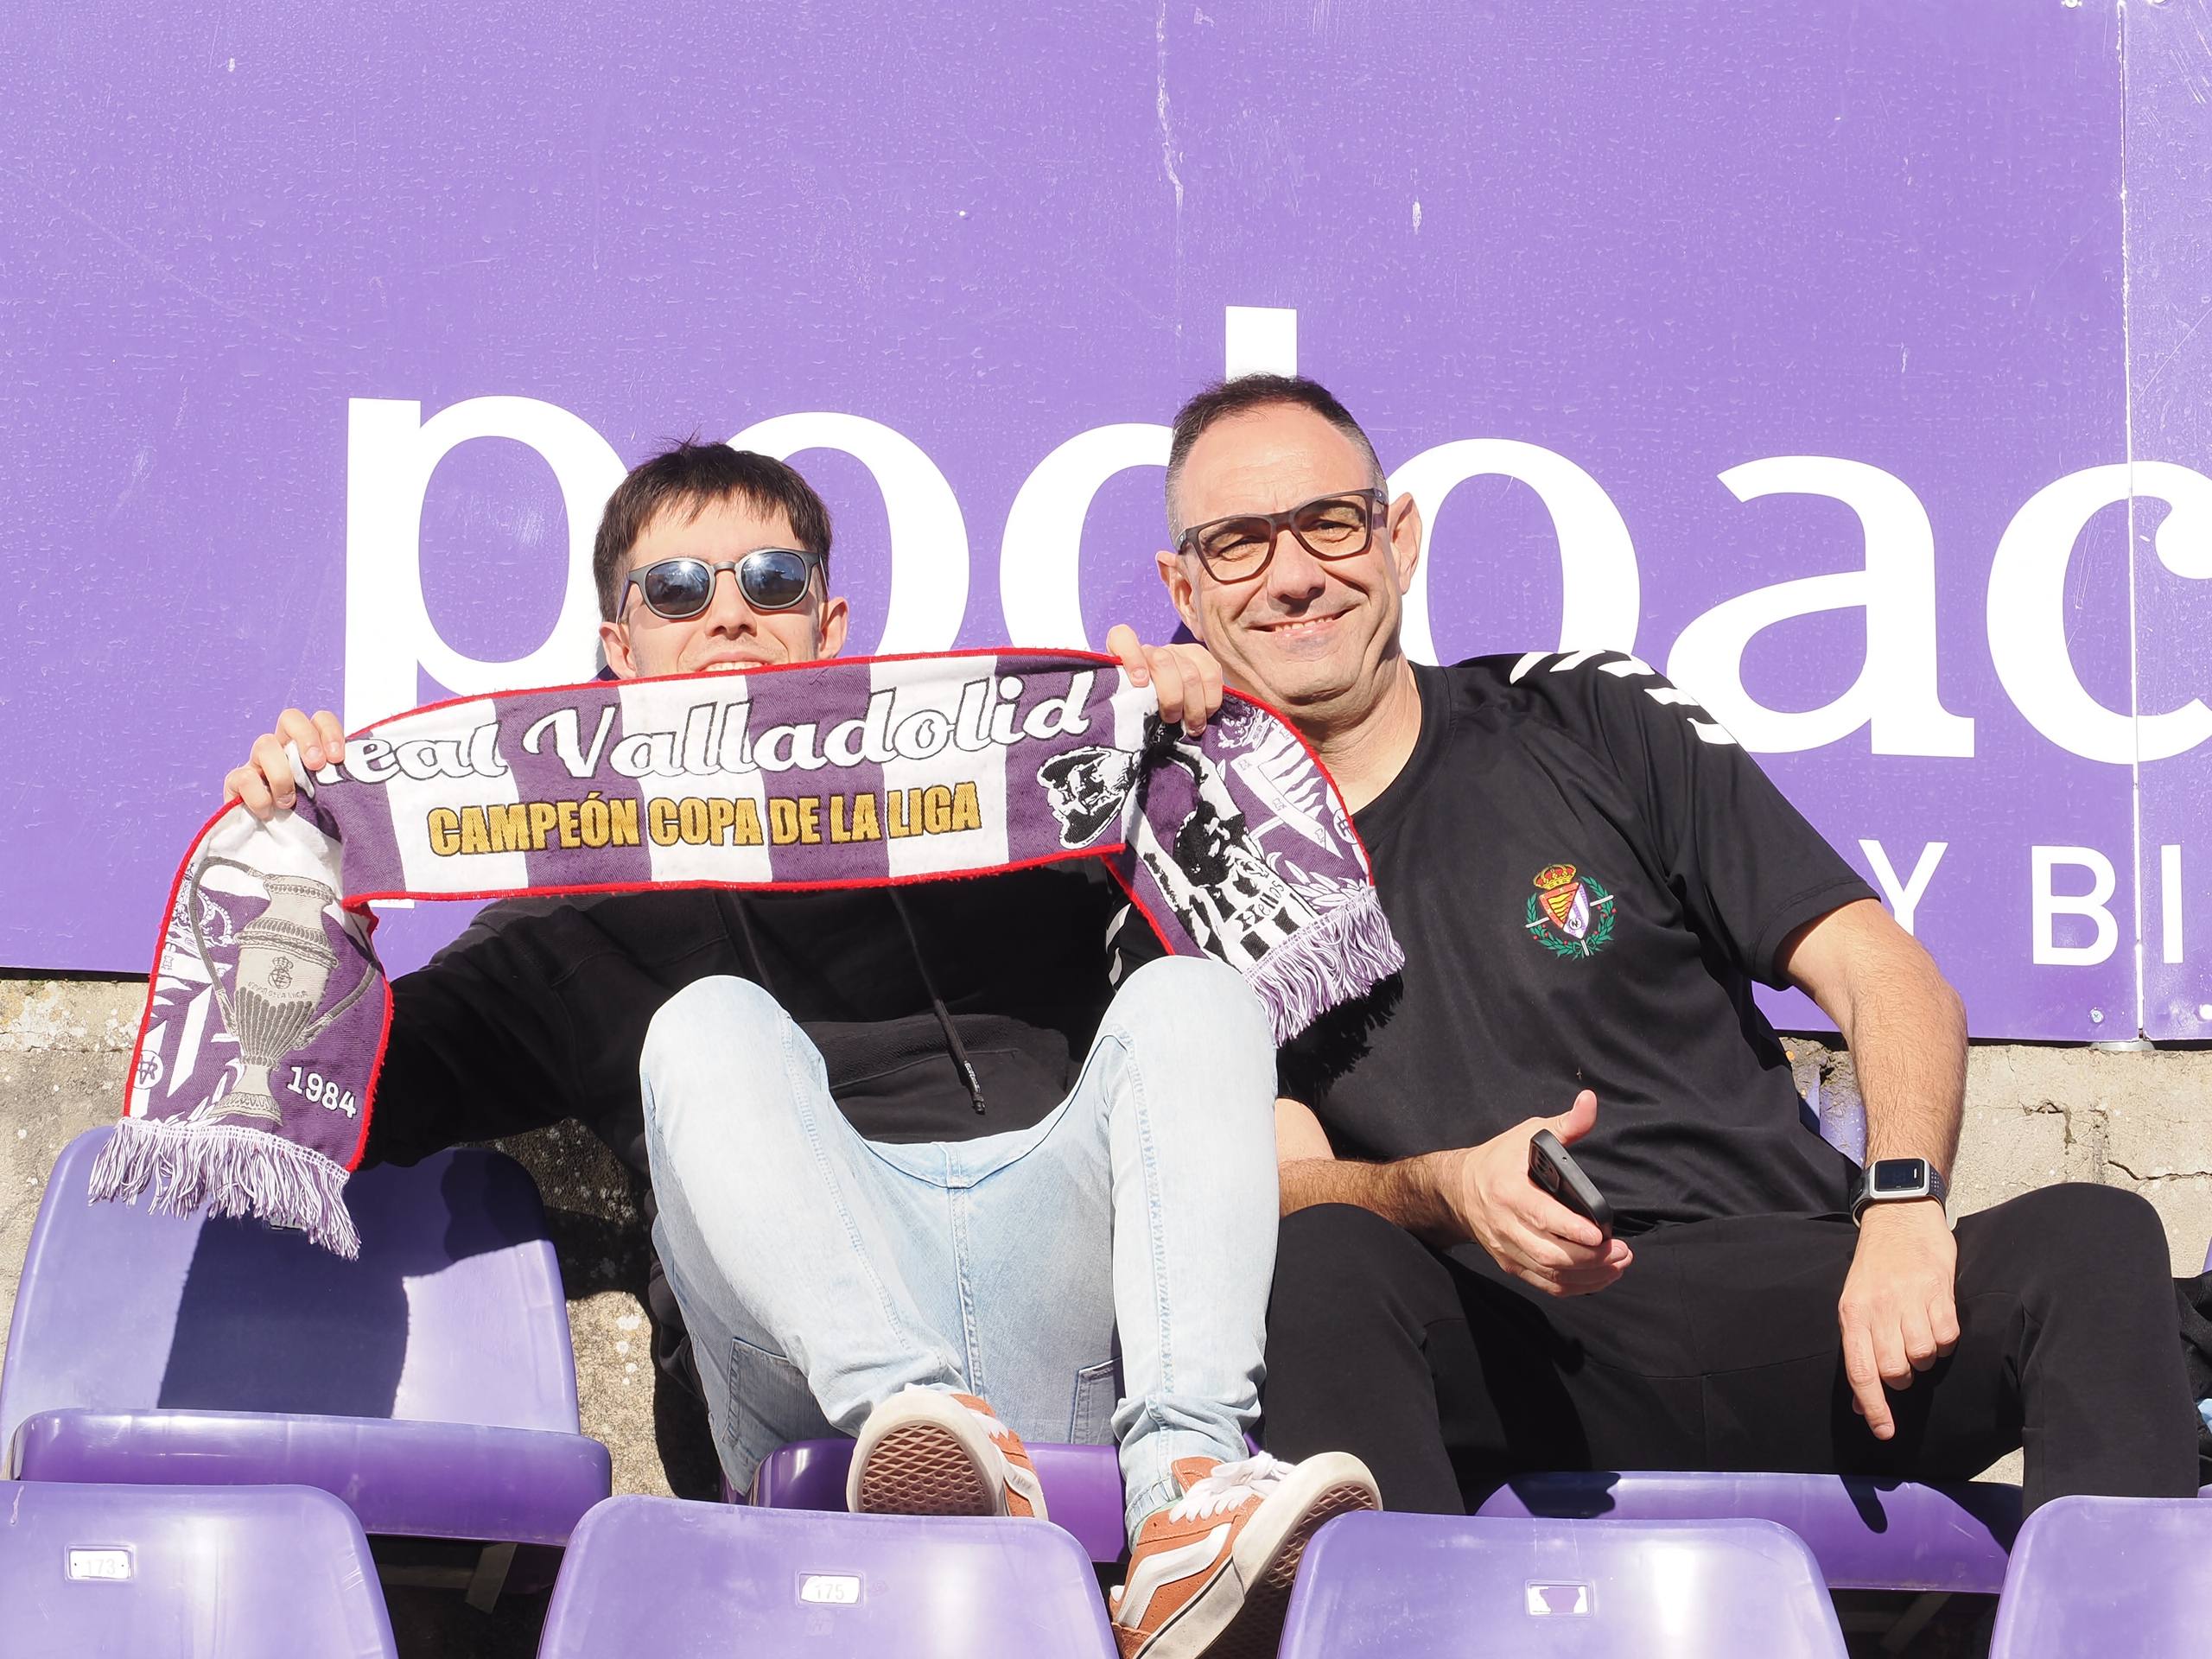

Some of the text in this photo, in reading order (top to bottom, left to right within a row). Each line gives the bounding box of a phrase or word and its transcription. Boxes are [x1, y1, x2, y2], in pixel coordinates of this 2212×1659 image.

[314, 671, 1096, 786] eal Valladolid
[427, 781, 982, 857] CAMPEÓN COPA DE LA LIGA
[1858, 838, 1949, 937] Y
[286, 1065, 358, 1119] 1984
[87, 1558, 116, 1576] 173
[815, 1583, 845, 1600] 175
